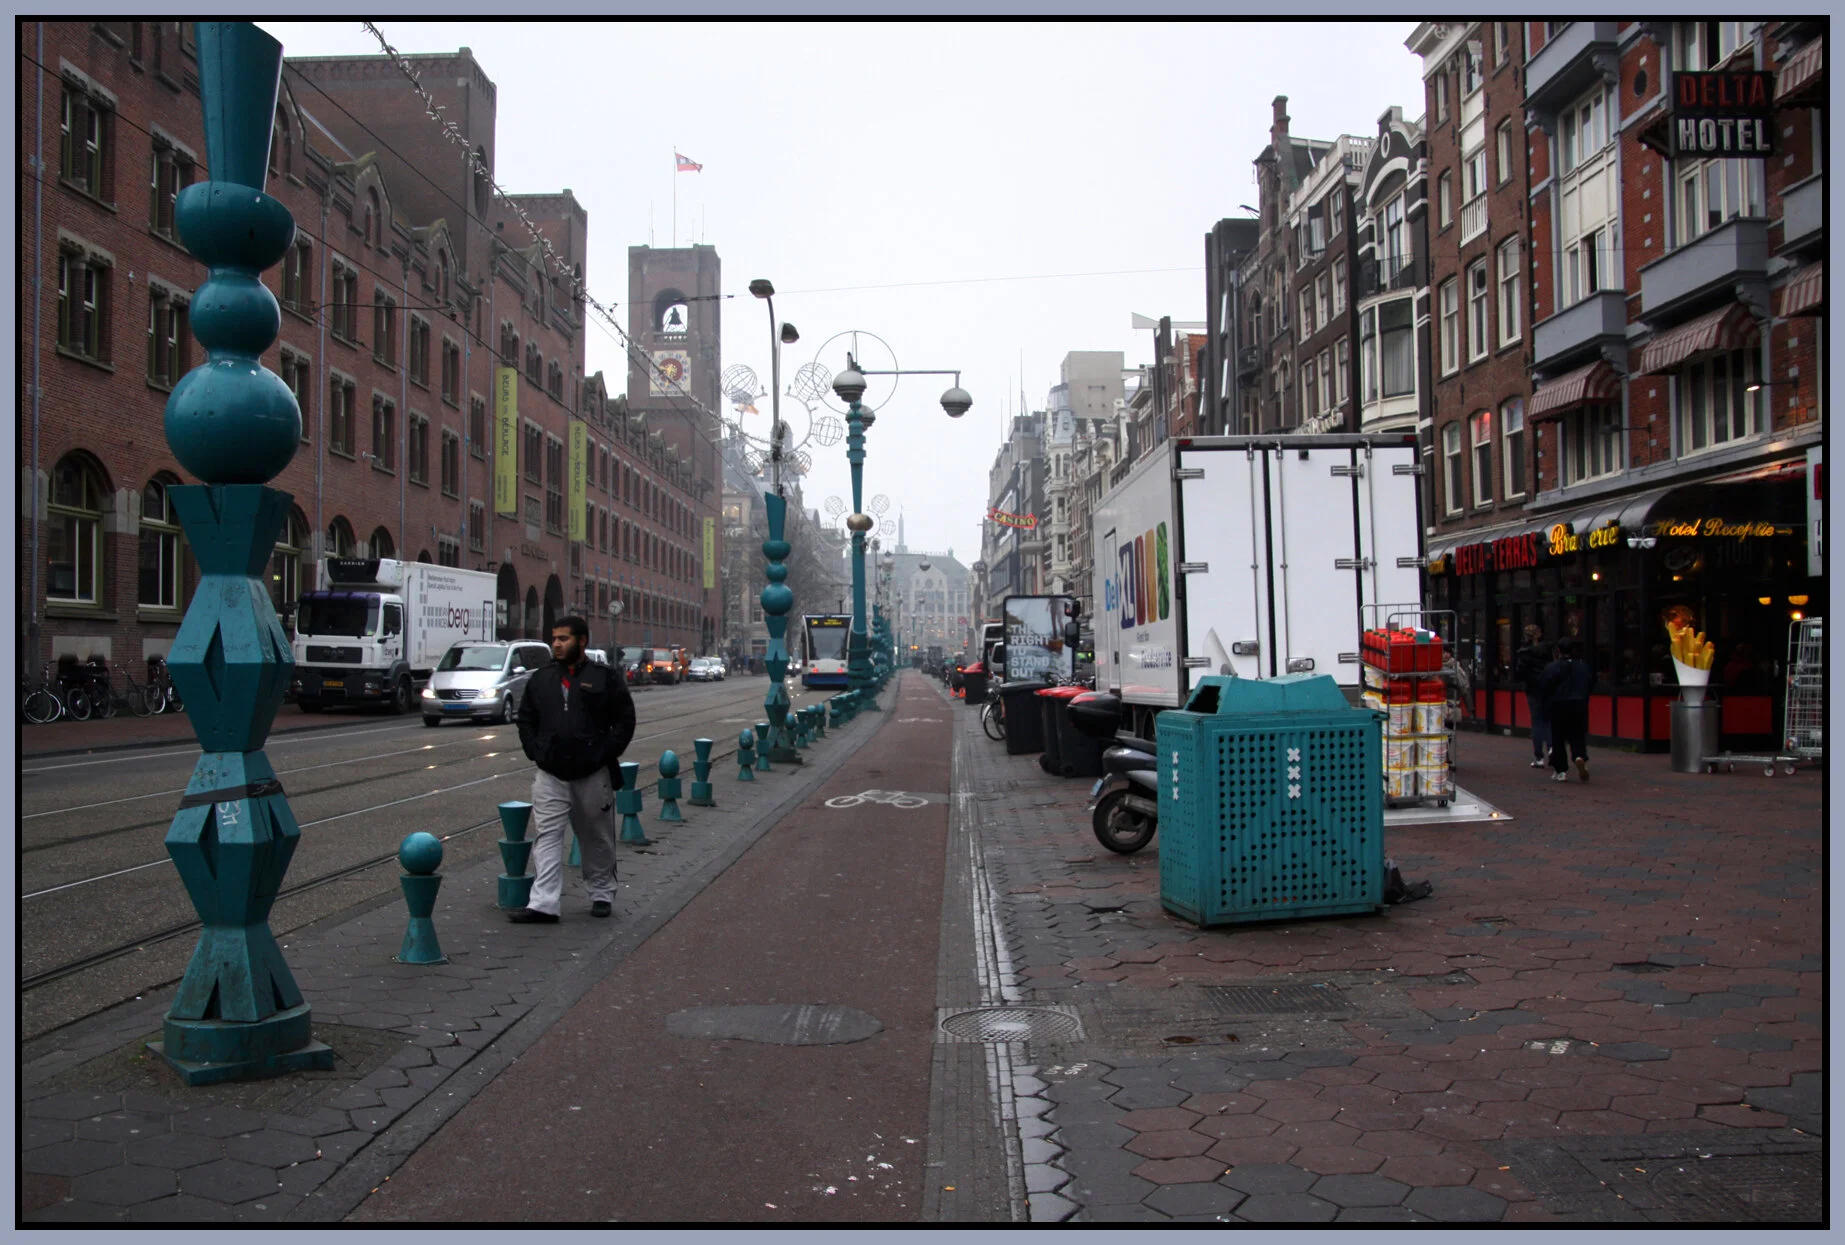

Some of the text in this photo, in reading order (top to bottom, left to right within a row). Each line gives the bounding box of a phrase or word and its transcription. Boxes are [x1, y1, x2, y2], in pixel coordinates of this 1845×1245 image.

[1680, 75, 1767, 107] DELTA
[1678, 118, 1770, 151] HOTEL
[994, 512, 1035, 526] CASINO
[1549, 519, 1620, 556] Braerie
[1653, 517, 1774, 543] Hotel Receptie
[448, 602, 469, 635] berg
[1011, 635, 1050, 646] RIGHT
[1012, 648, 1026, 656] TO
[1011, 657, 1050, 668] STAND
[1011, 668, 1031, 678] OUT
